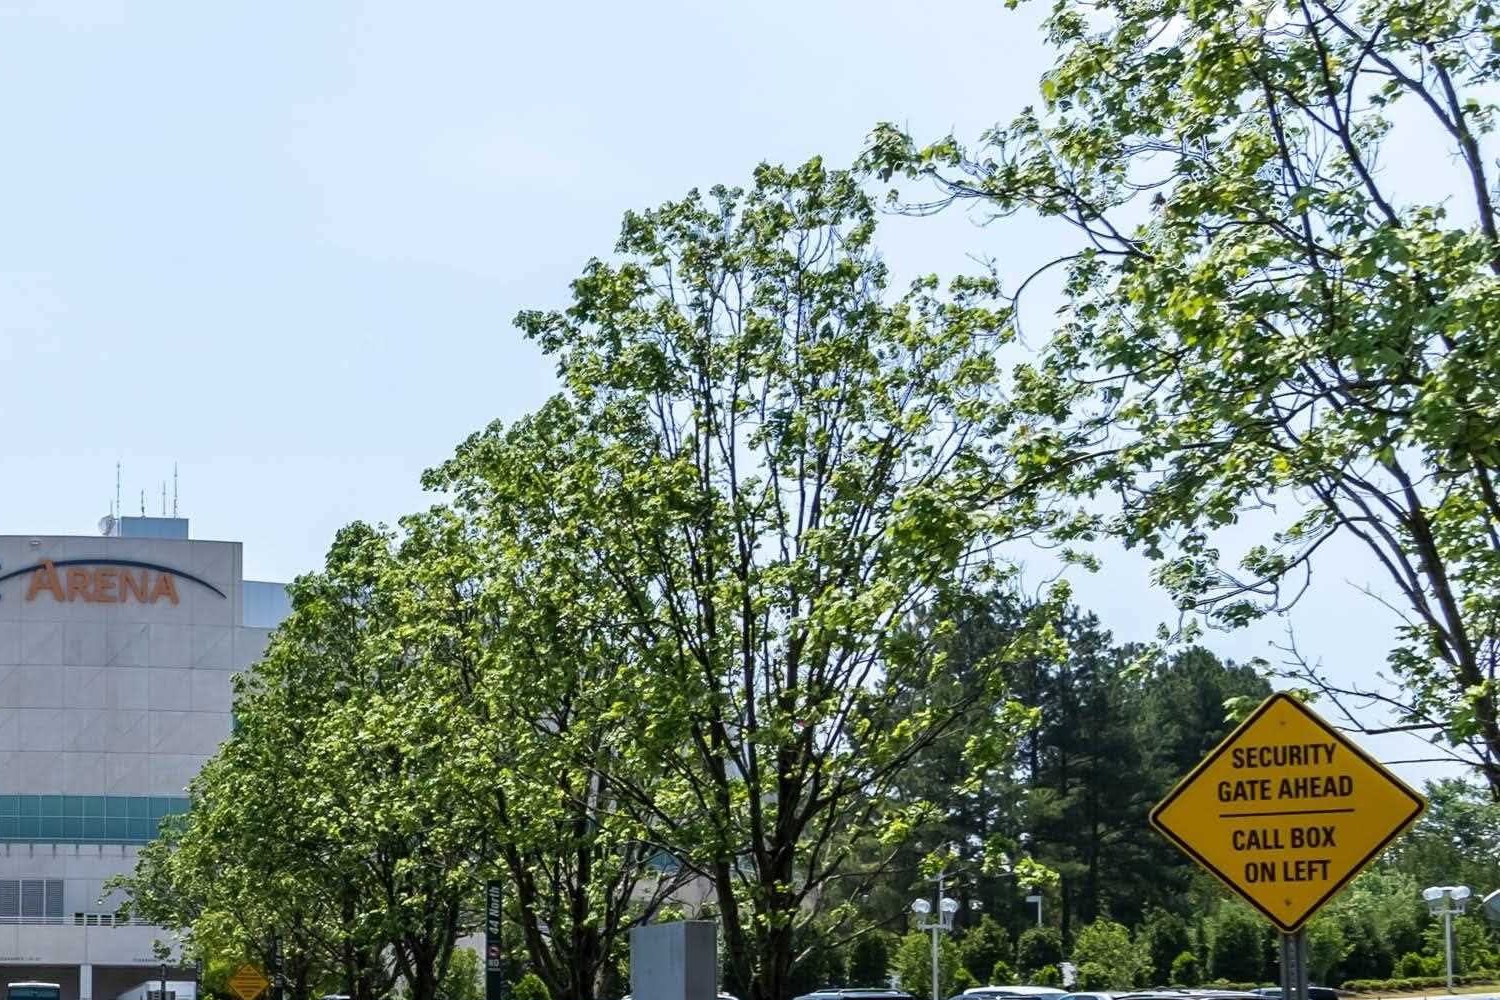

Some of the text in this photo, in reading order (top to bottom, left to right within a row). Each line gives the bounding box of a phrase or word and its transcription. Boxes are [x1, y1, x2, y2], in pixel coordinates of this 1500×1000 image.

[25, 558, 180, 607] ARENA
[1232, 743, 1337, 769] SECURITY
[1218, 775, 1353, 802] GATE AHEAD
[1232, 826, 1336, 851] CALL BOX
[1245, 859, 1332, 883] ON LEFT
[488, 886, 501, 917] North
